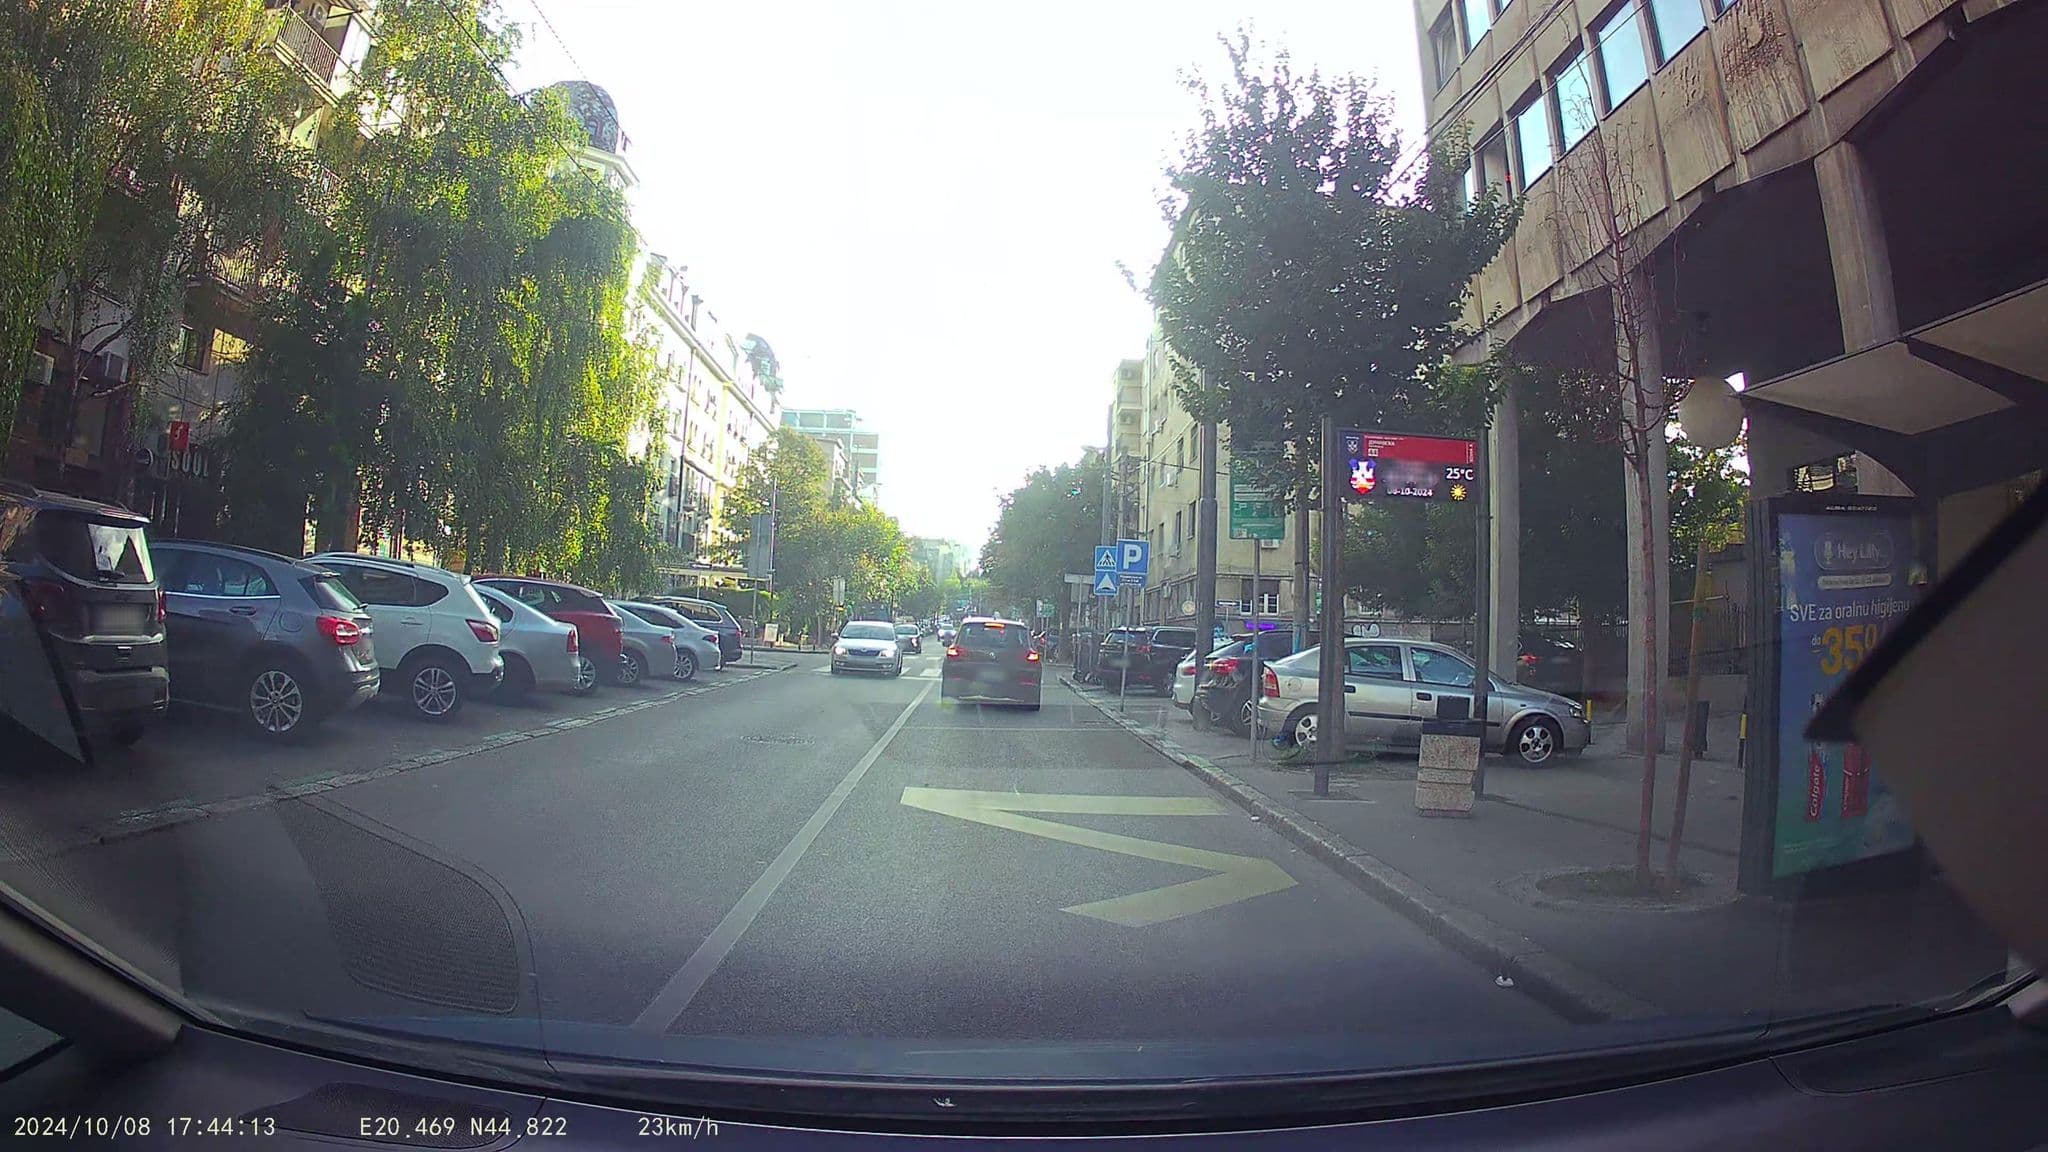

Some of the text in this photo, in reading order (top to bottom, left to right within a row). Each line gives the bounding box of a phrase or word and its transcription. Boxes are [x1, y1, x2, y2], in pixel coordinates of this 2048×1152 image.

[1446, 468, 1474, 480] 25°C
[1124, 544, 1142, 569] P
[1838, 543, 1858, 564] Hey
[1790, 598, 1911, 622] SVE za oralnu higijenu
[1811, 633, 1822, 647] do
[1809, 764, 1822, 817] Colgate
